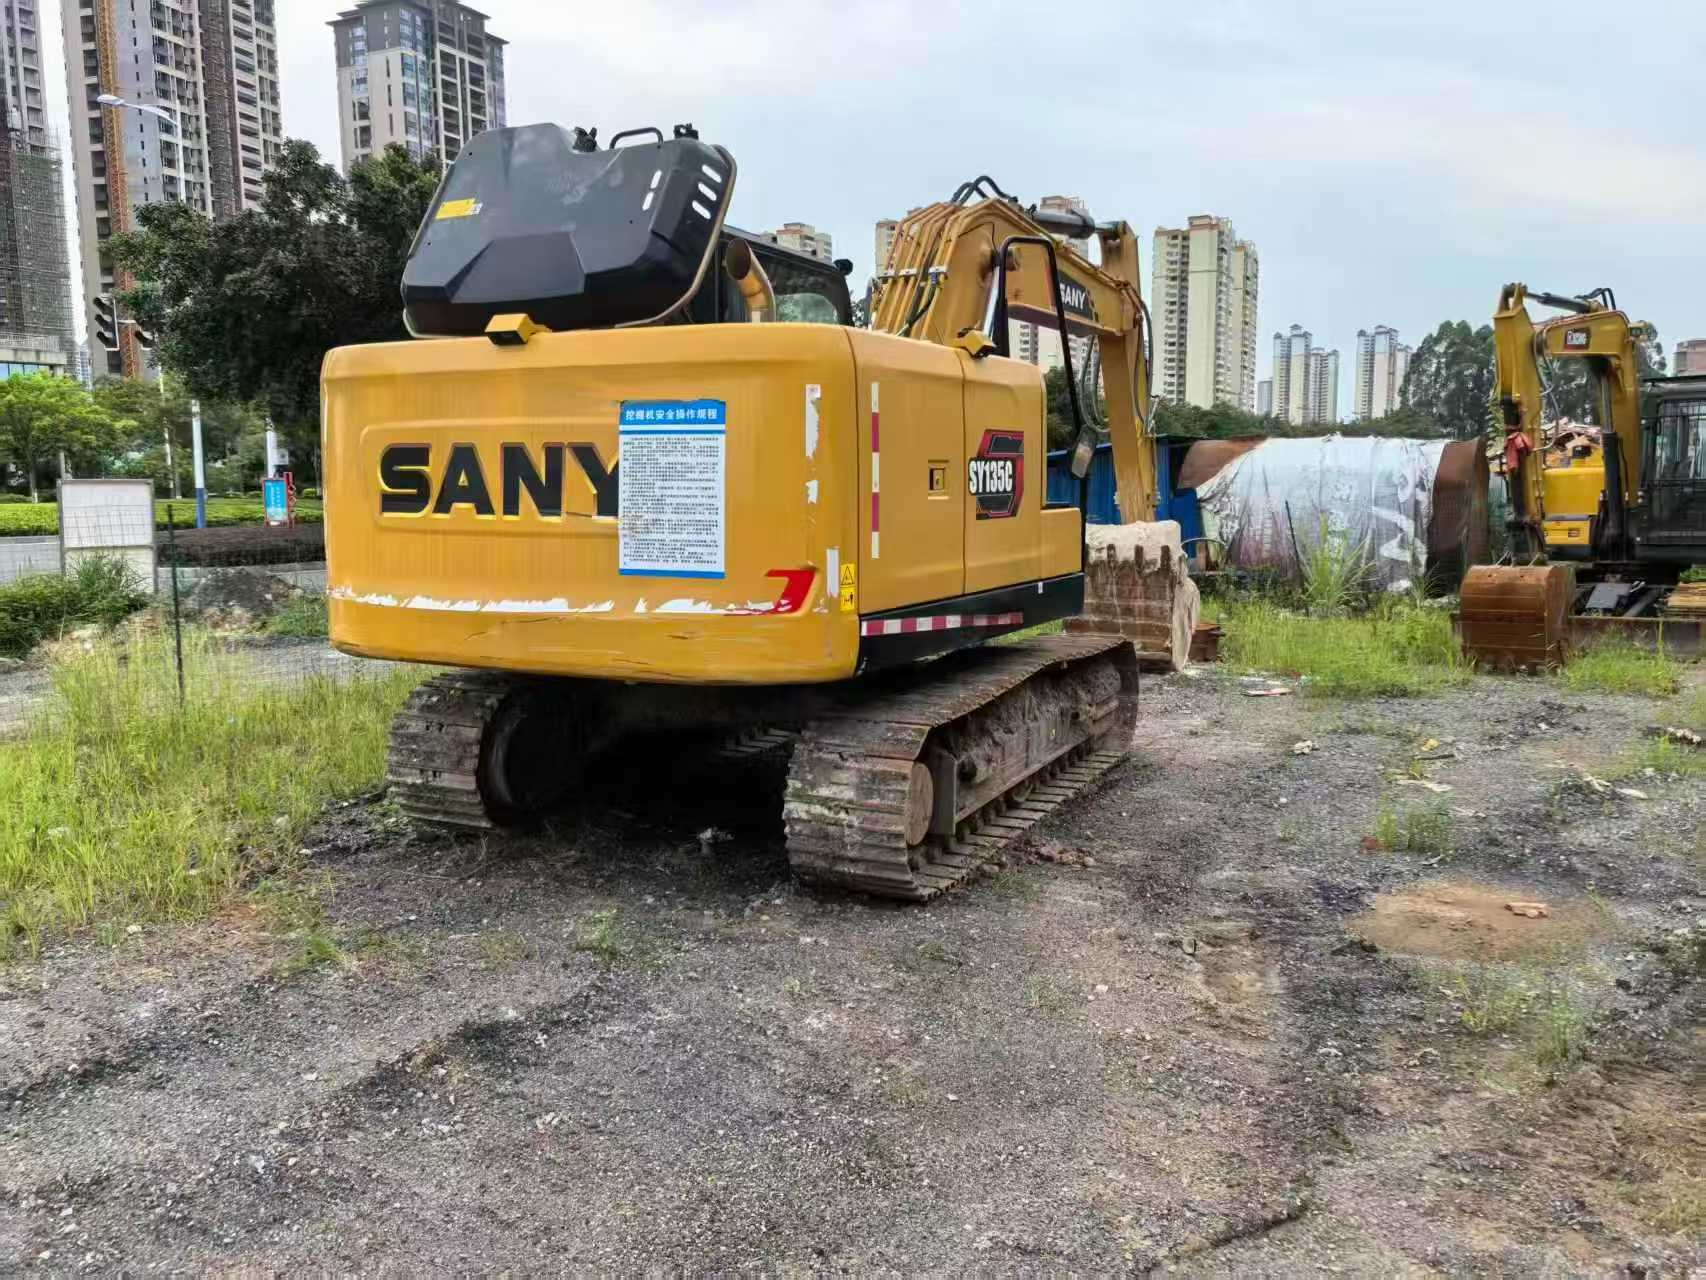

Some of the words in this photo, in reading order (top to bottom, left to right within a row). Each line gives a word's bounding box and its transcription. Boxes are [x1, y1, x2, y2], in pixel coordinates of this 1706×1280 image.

[1059, 282, 1086, 310] SANY
[625, 403, 718, 420] 挖掘机安全操作规程
[379, 442, 620, 522] SANY
[969, 460, 1013, 494] SY135C
